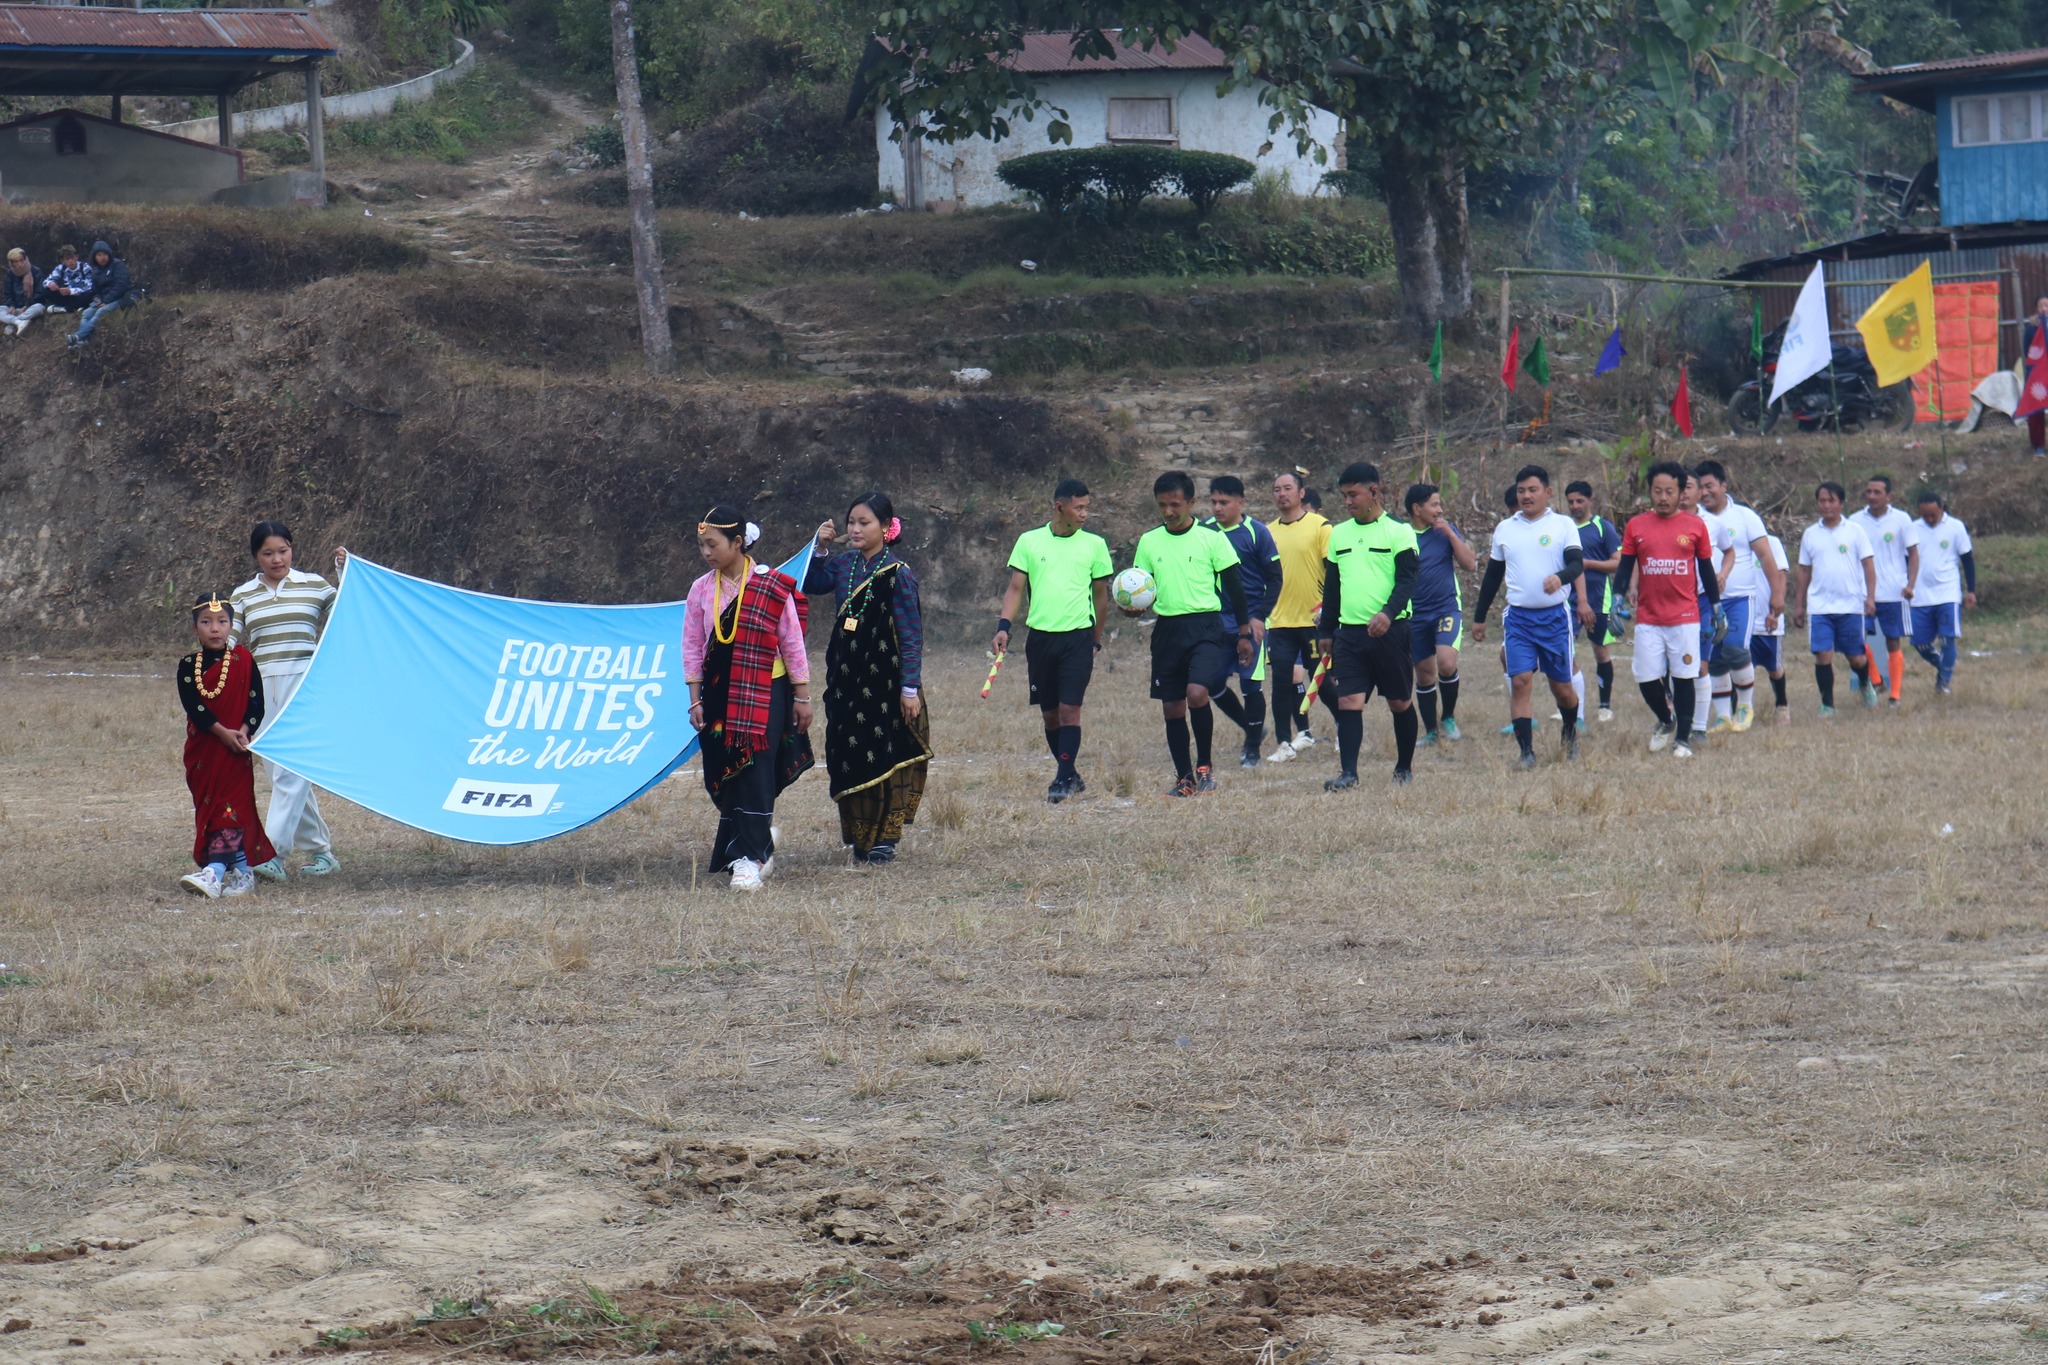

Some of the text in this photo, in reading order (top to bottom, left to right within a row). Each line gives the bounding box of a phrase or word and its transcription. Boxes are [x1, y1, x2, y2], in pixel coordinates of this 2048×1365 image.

[1641, 565, 1675, 575] Viewer
[1646, 556, 1675, 567] Team
[498, 638, 668, 680] FOOTBALL
[484, 678, 663, 731] UNITES
[467, 730, 654, 770] the World
[461, 790, 533, 808] FIFA
